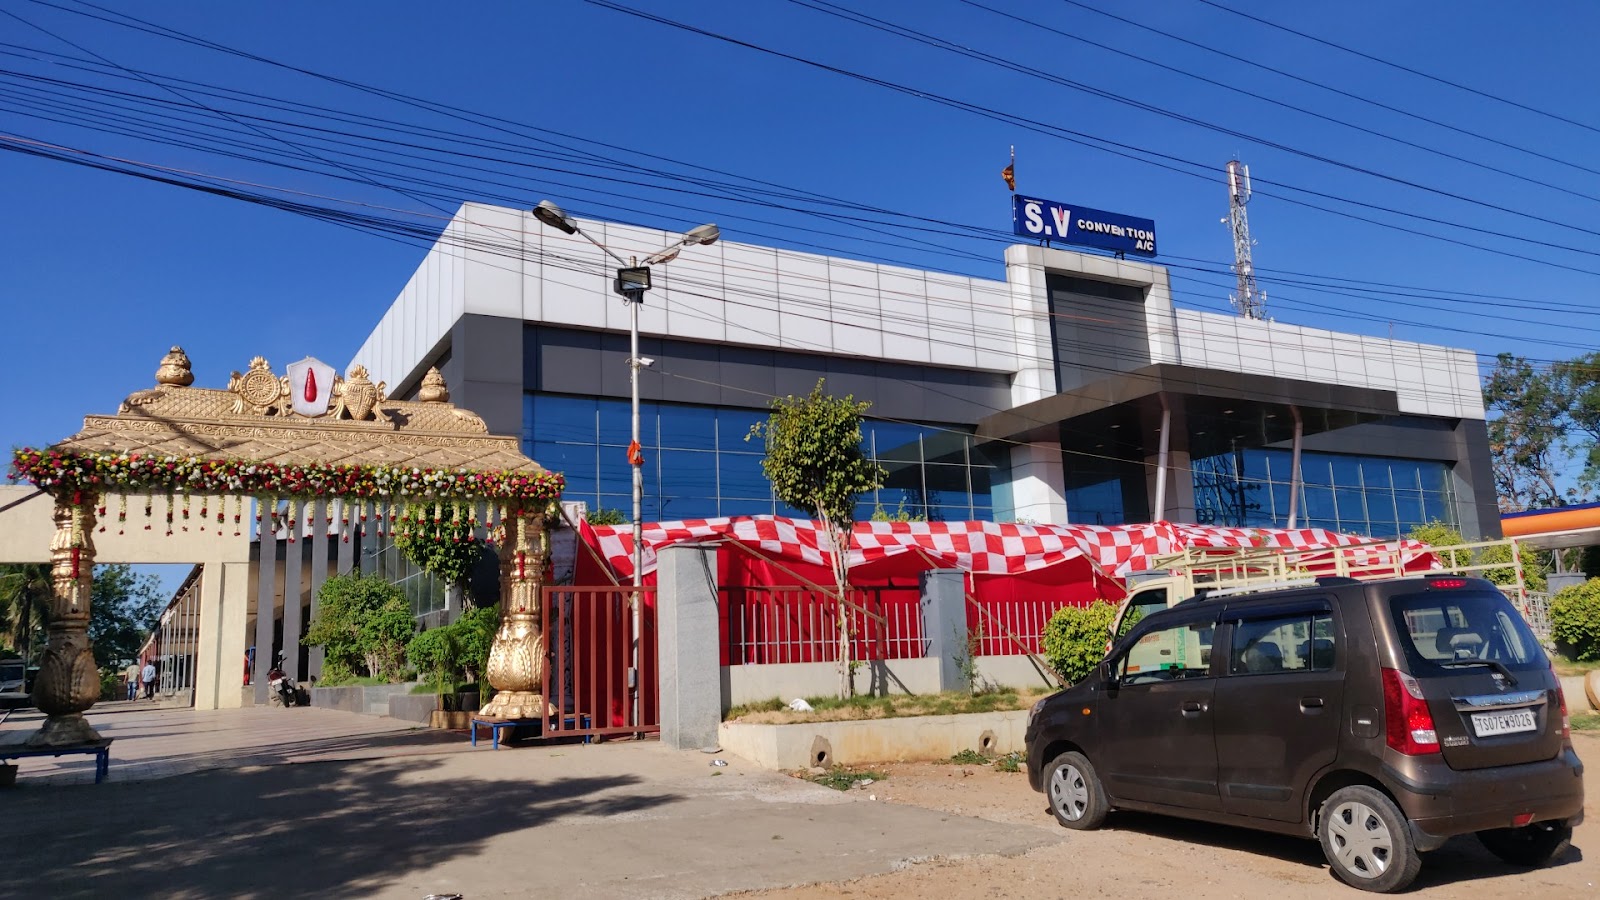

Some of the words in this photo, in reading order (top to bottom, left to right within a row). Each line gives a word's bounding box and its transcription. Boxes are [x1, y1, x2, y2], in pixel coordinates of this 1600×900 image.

[1024, 202, 1071, 238] S.V
[1077, 219, 1154, 241] CONVENTION
[1136, 239, 1154, 251] A/C
